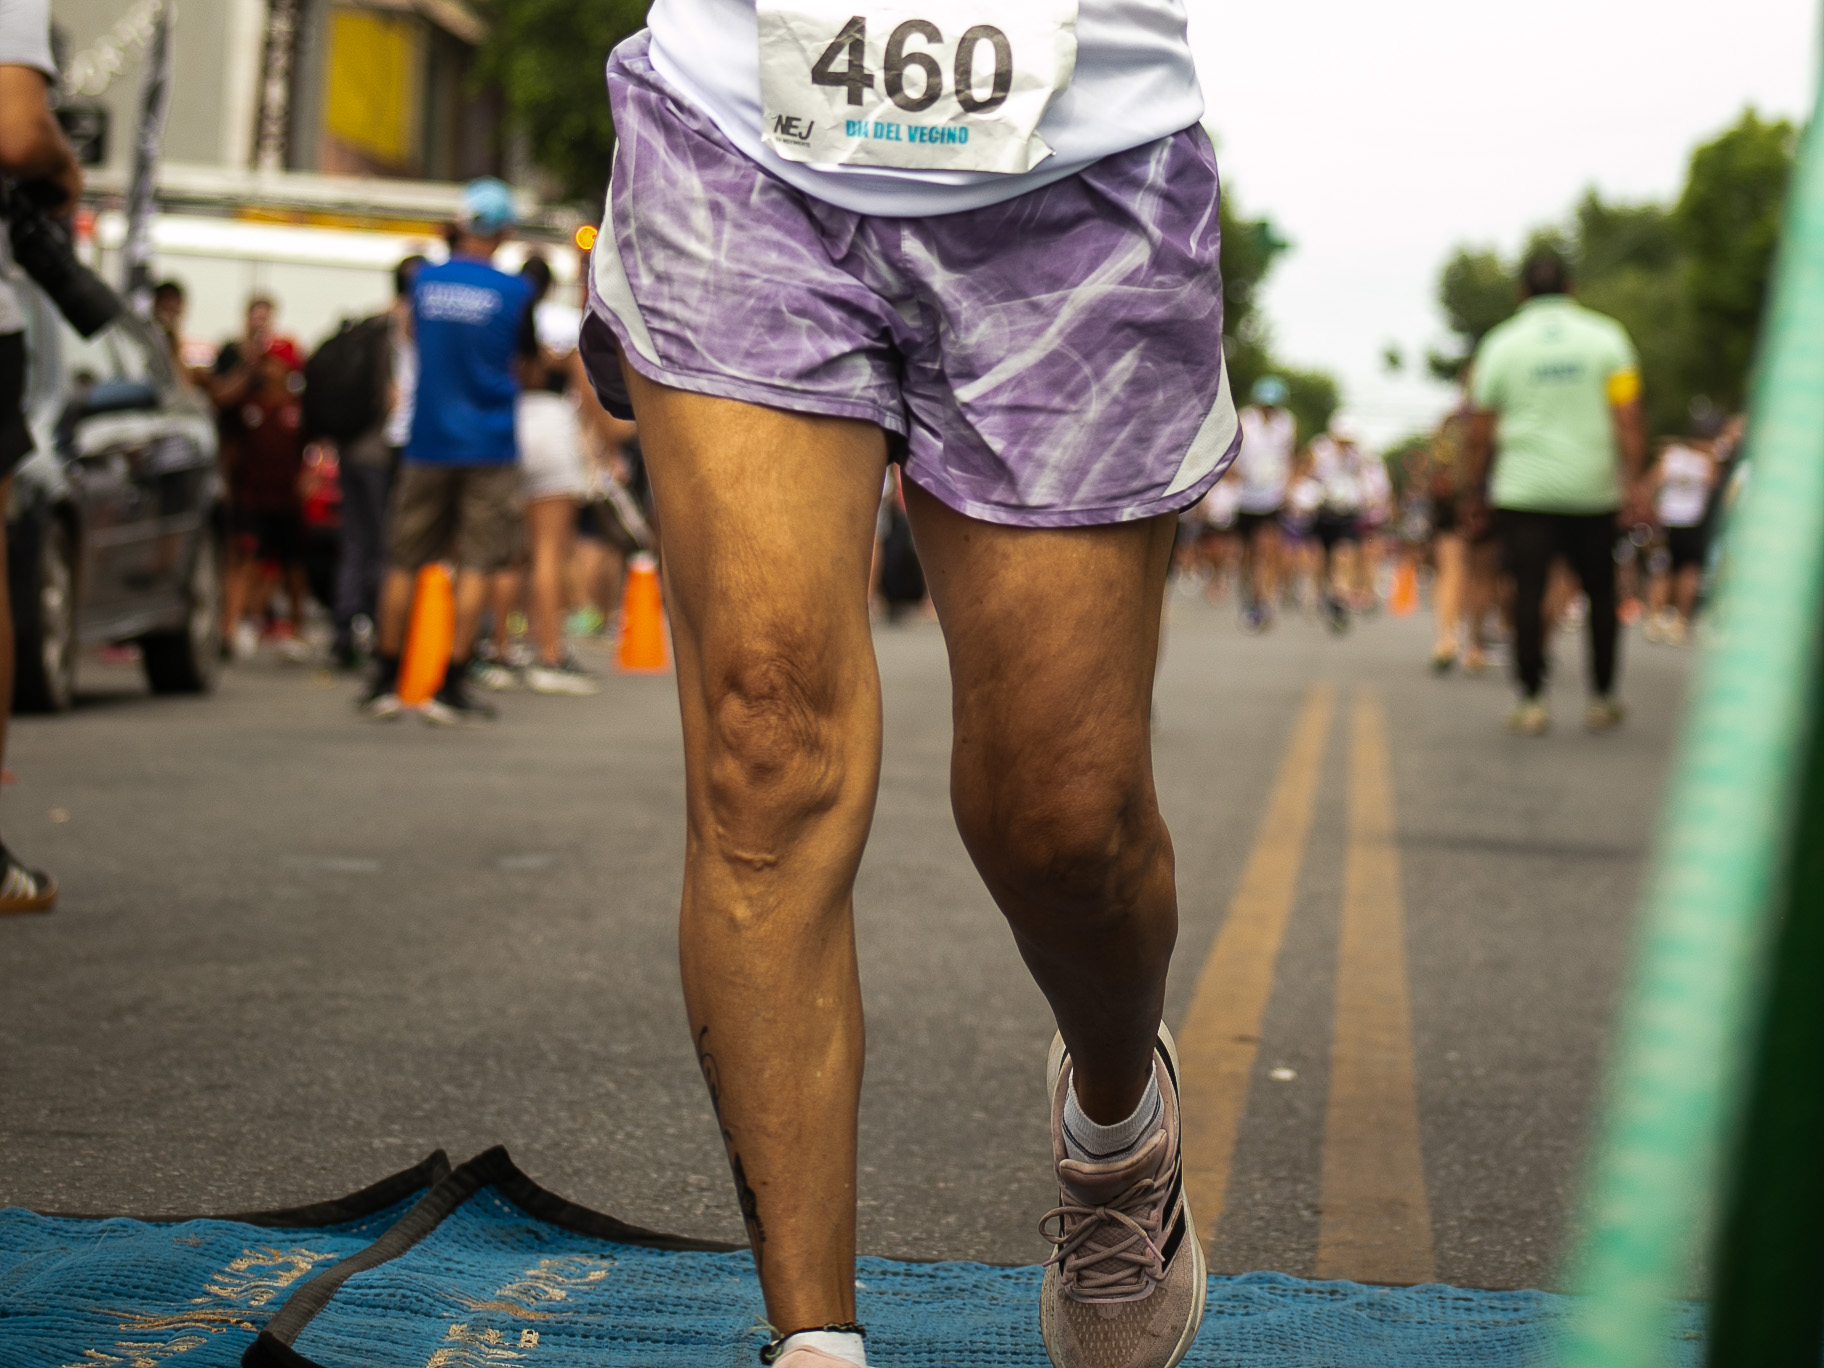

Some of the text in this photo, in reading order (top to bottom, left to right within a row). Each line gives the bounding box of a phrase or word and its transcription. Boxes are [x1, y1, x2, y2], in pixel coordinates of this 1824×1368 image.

[811, 15, 1013, 115] 460
[773, 113, 815, 140] NEJ
[873, 121, 902, 142] DEL
[907, 124, 969, 145] VECINO
